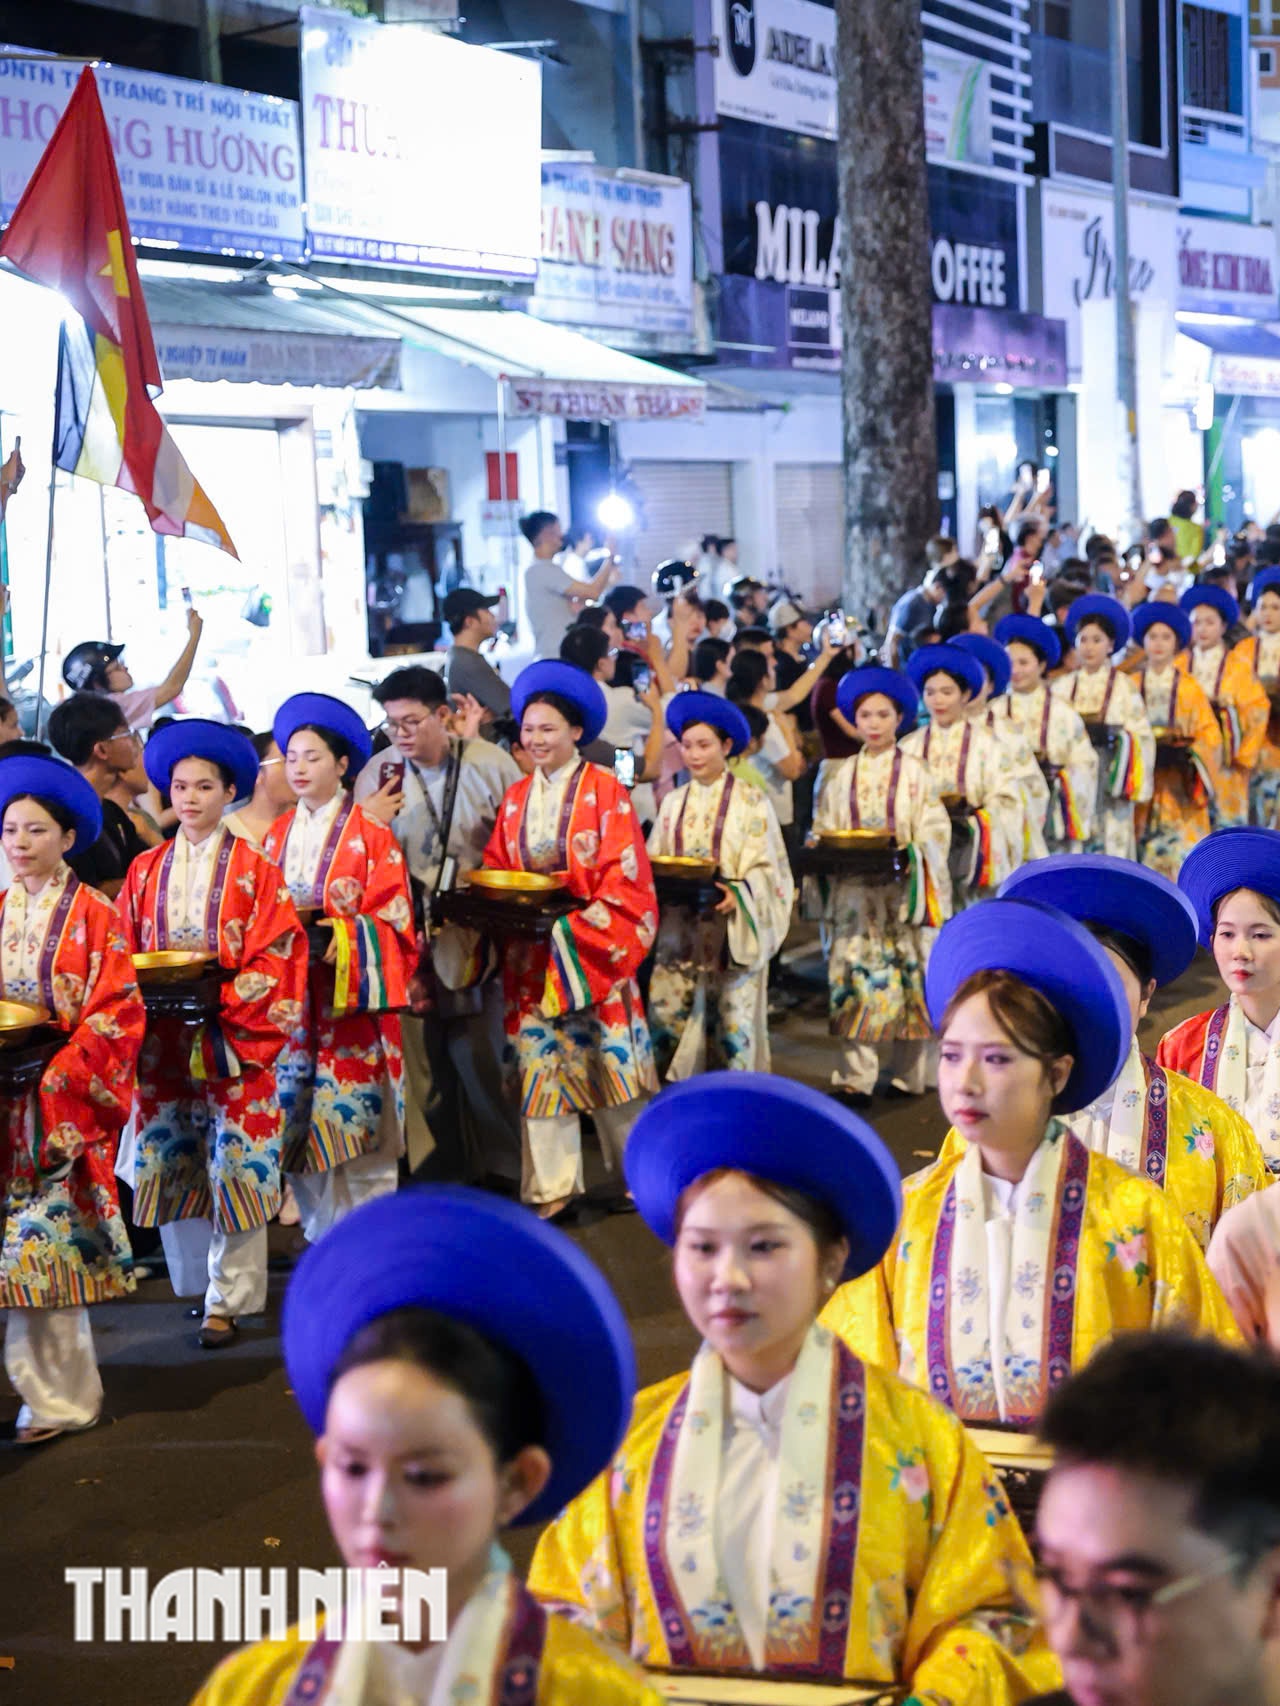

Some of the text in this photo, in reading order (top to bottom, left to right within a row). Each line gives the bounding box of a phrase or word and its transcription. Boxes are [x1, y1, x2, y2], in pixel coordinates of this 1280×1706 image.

[101, 78, 167, 105] TRANG
[166, 124, 295, 181] HƯƠNG
[932, 239, 1007, 306] OFFEE
